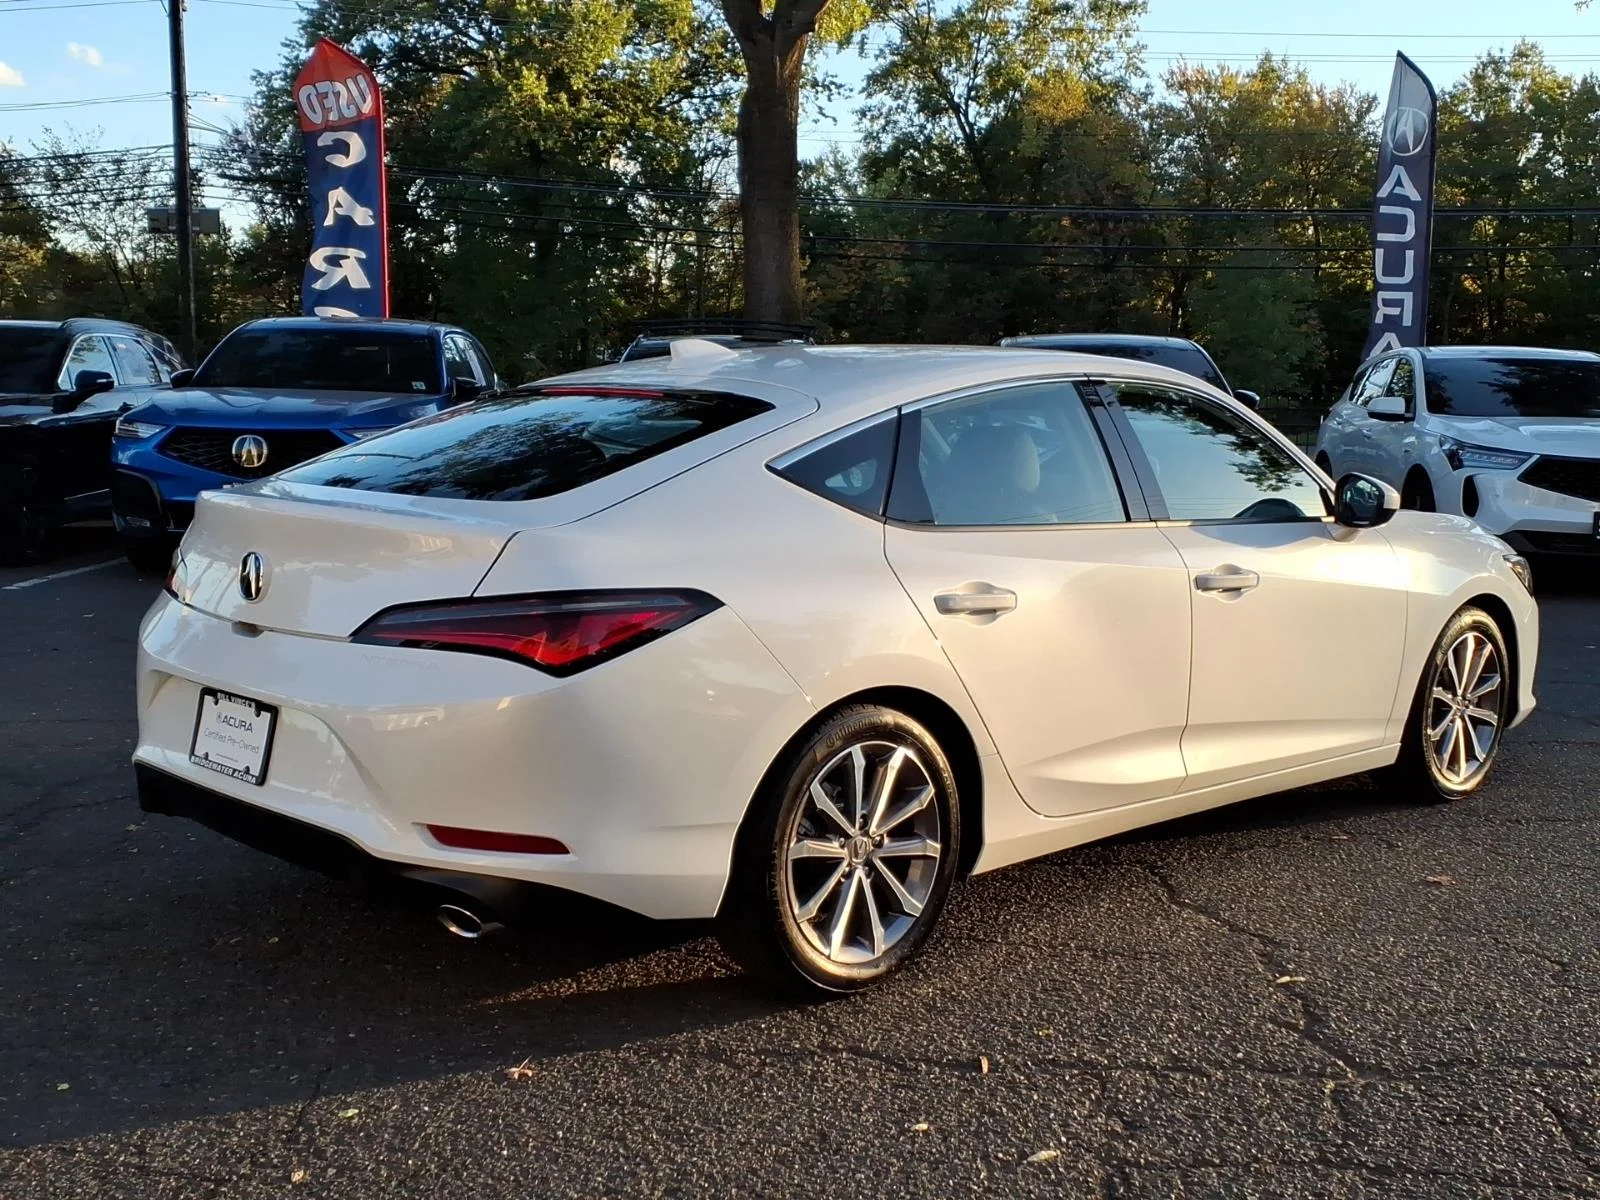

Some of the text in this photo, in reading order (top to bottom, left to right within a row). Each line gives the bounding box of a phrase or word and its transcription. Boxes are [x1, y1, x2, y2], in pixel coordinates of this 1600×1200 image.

[222, 714, 253, 733] ACURA
[191, 755, 233, 775] BRIDGEWATER
[233, 770, 257, 784] ACURA
